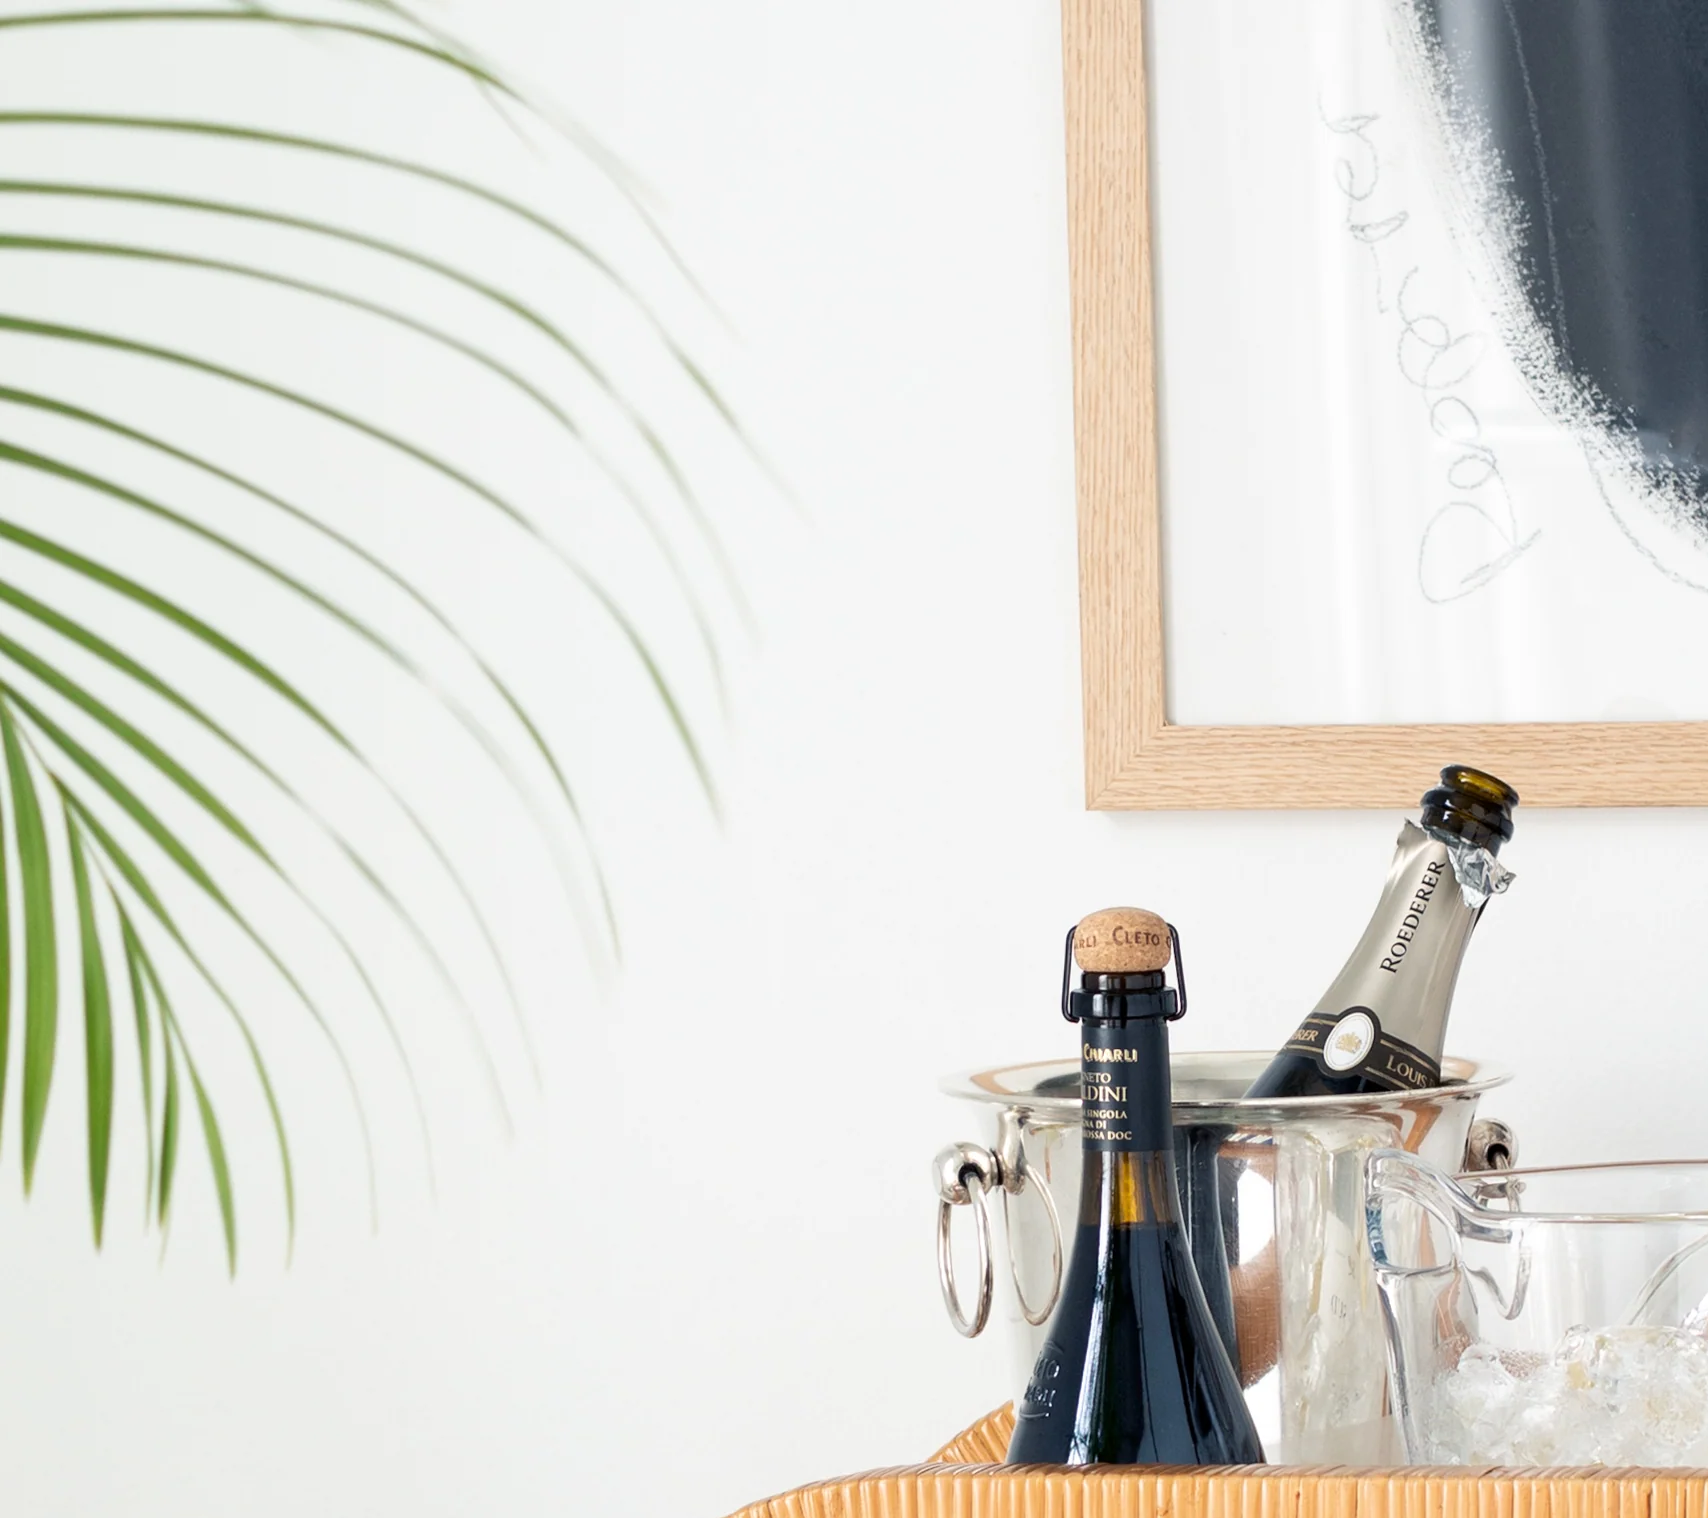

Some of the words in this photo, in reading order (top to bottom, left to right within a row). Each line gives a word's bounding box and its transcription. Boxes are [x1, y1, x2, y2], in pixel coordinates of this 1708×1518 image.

[1380, 861, 1446, 973] ROEDERER
[1074, 935, 1097, 950] RLI
[1112, 925, 1160, 946] CLETO
[1083, 1043, 1138, 1062] CHIARLI
[1386, 1054, 1428, 1089] LOUIS
[1081, 1085, 1128, 1102] LDINI
[1095, 1120, 1107, 1130] DI
[1107, 1131, 1132, 1140] DOC
